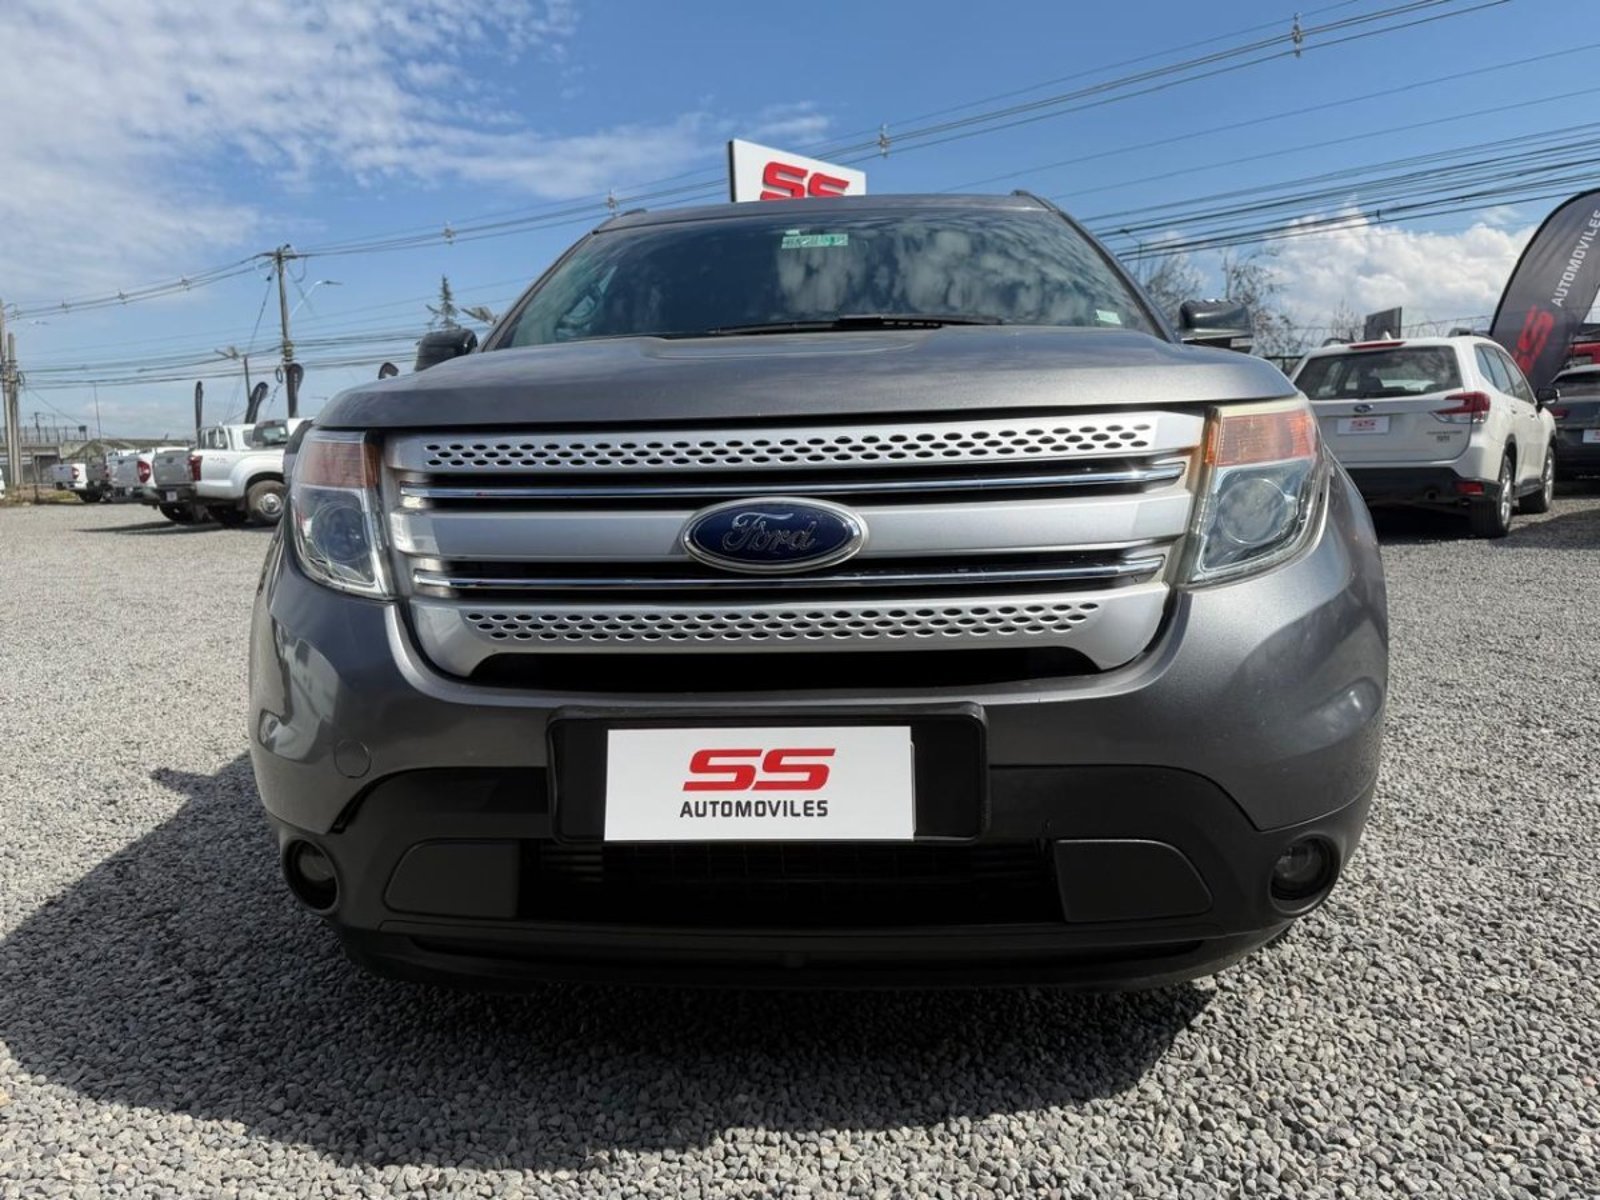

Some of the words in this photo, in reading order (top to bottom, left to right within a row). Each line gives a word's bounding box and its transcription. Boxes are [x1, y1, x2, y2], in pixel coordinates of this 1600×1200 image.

[721, 511, 817, 553] Ford
[682, 748, 836, 792] SS
[679, 799, 829, 818] AUTOMOVILES
